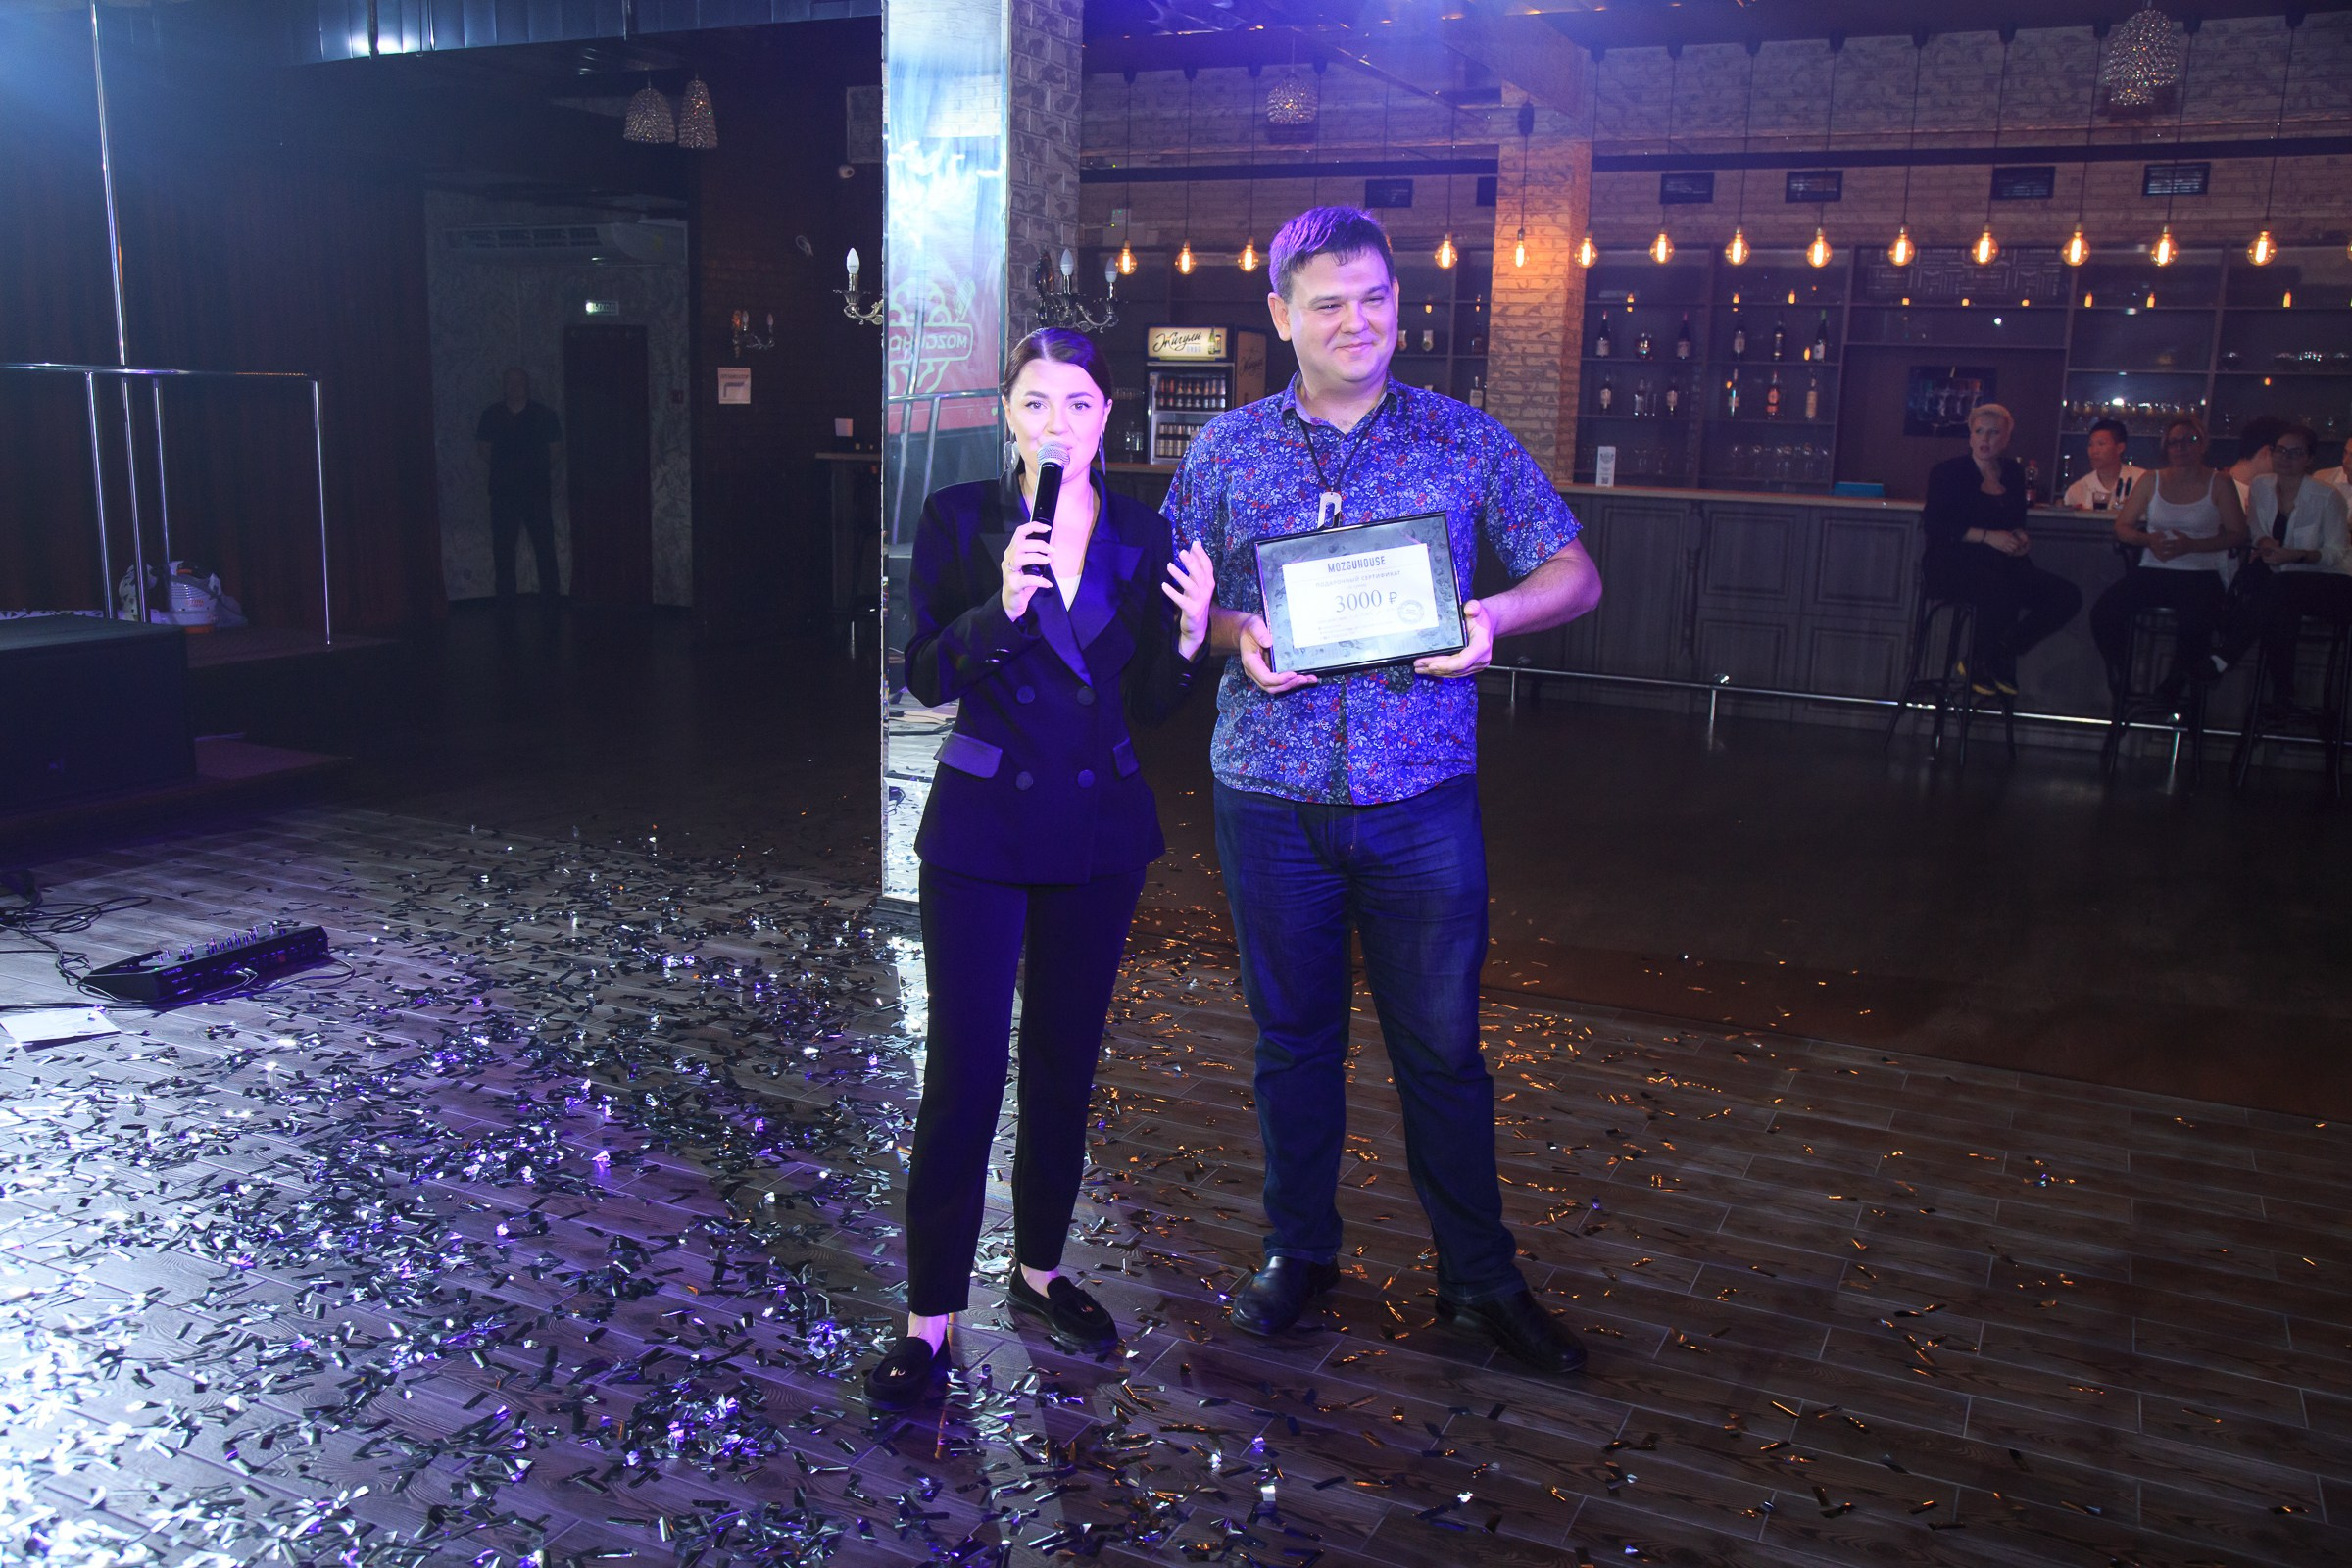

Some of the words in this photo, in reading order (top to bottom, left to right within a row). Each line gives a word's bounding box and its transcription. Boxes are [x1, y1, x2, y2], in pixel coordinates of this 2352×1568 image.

[1152, 331, 1202, 353] Жигули
[1327, 555, 1386, 573] MOZGUHOUSE
[1360, 570, 1400, 581] СЕРТИФИКАТ
[1334, 589, 1382, 612] 3000
